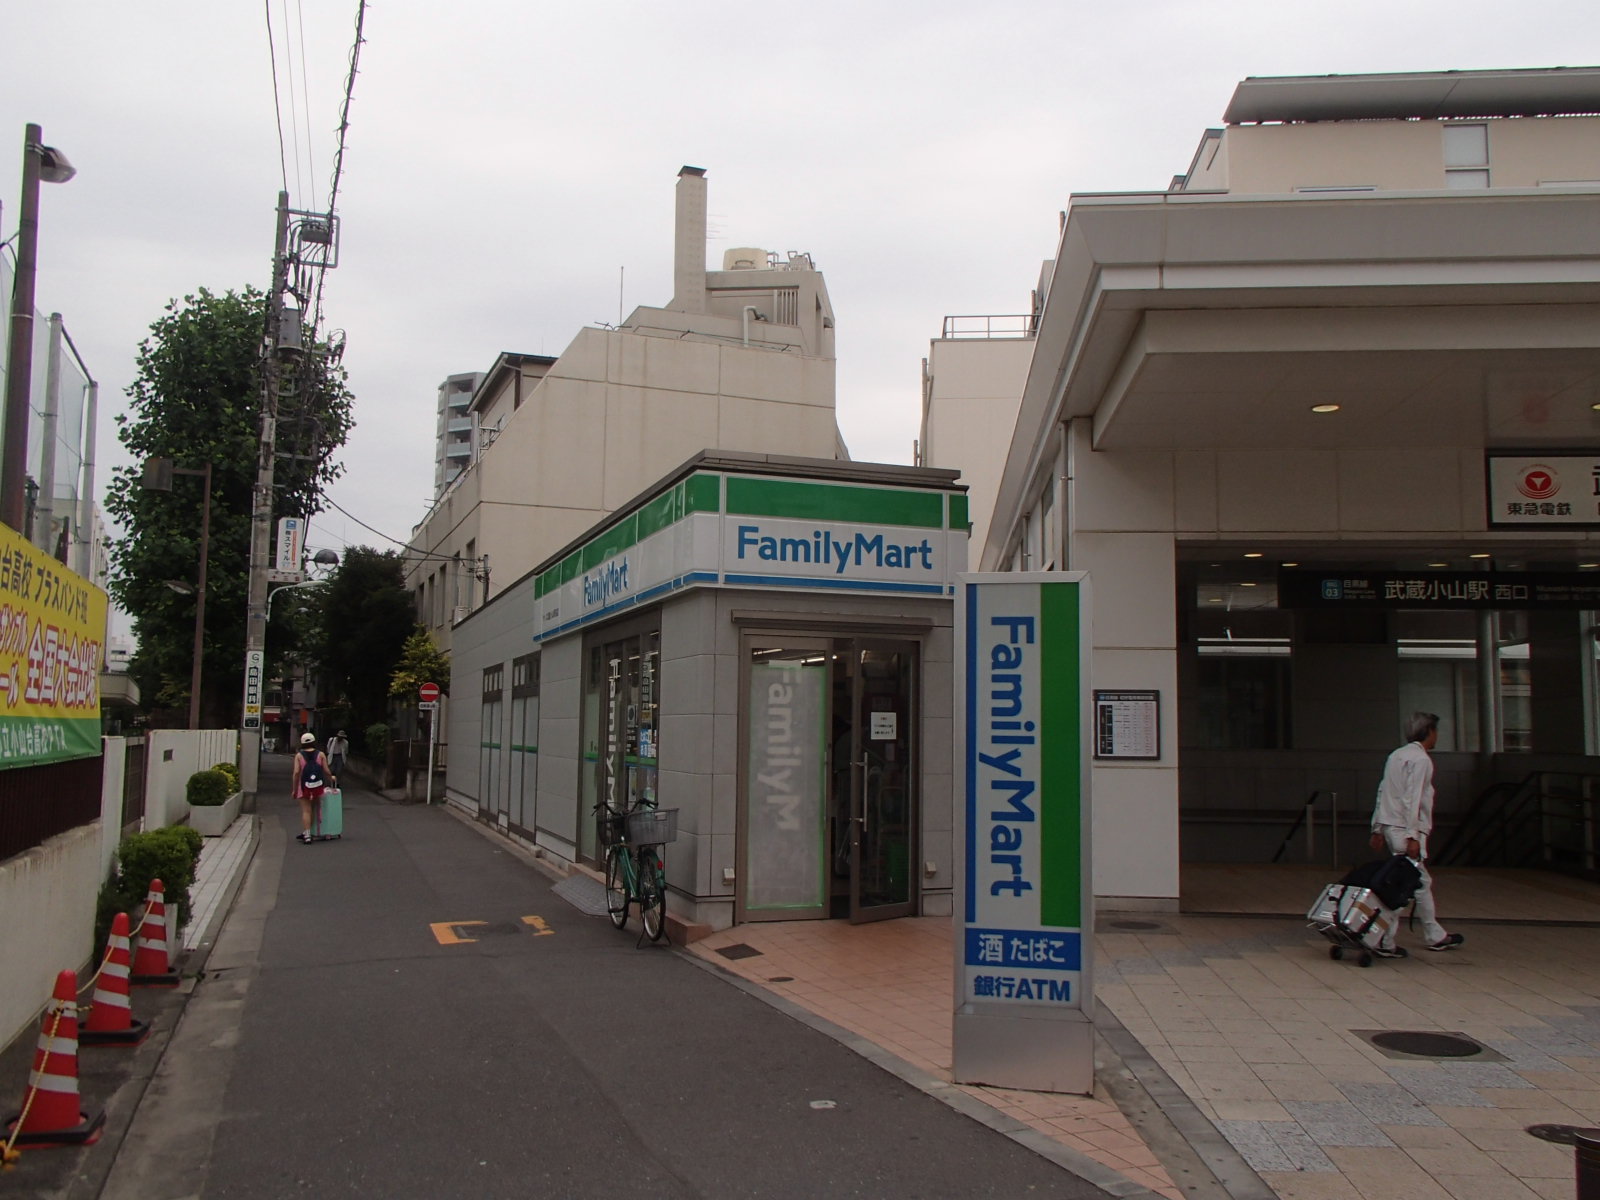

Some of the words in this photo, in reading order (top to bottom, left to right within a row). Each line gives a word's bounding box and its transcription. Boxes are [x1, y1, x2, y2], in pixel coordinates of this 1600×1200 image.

[1507, 503, 1572, 516] 東急電鉄
[737, 525, 933, 574] FamilyMart
[0, 543, 33, 601] 台高校
[583, 555, 628, 608] FamilyMart
[1384, 580, 1489, 601] 武蔵小山駅
[1495, 585, 1529, 600] 西口
[0, 723, 67, 759] 立小山台高校PTA
[978, 616, 1035, 897] FamilyMart
[978, 933, 1004, 962] 酒
[1011, 937, 1065, 963] たばこ
[974, 974, 1071, 1002] 銀行ATM
